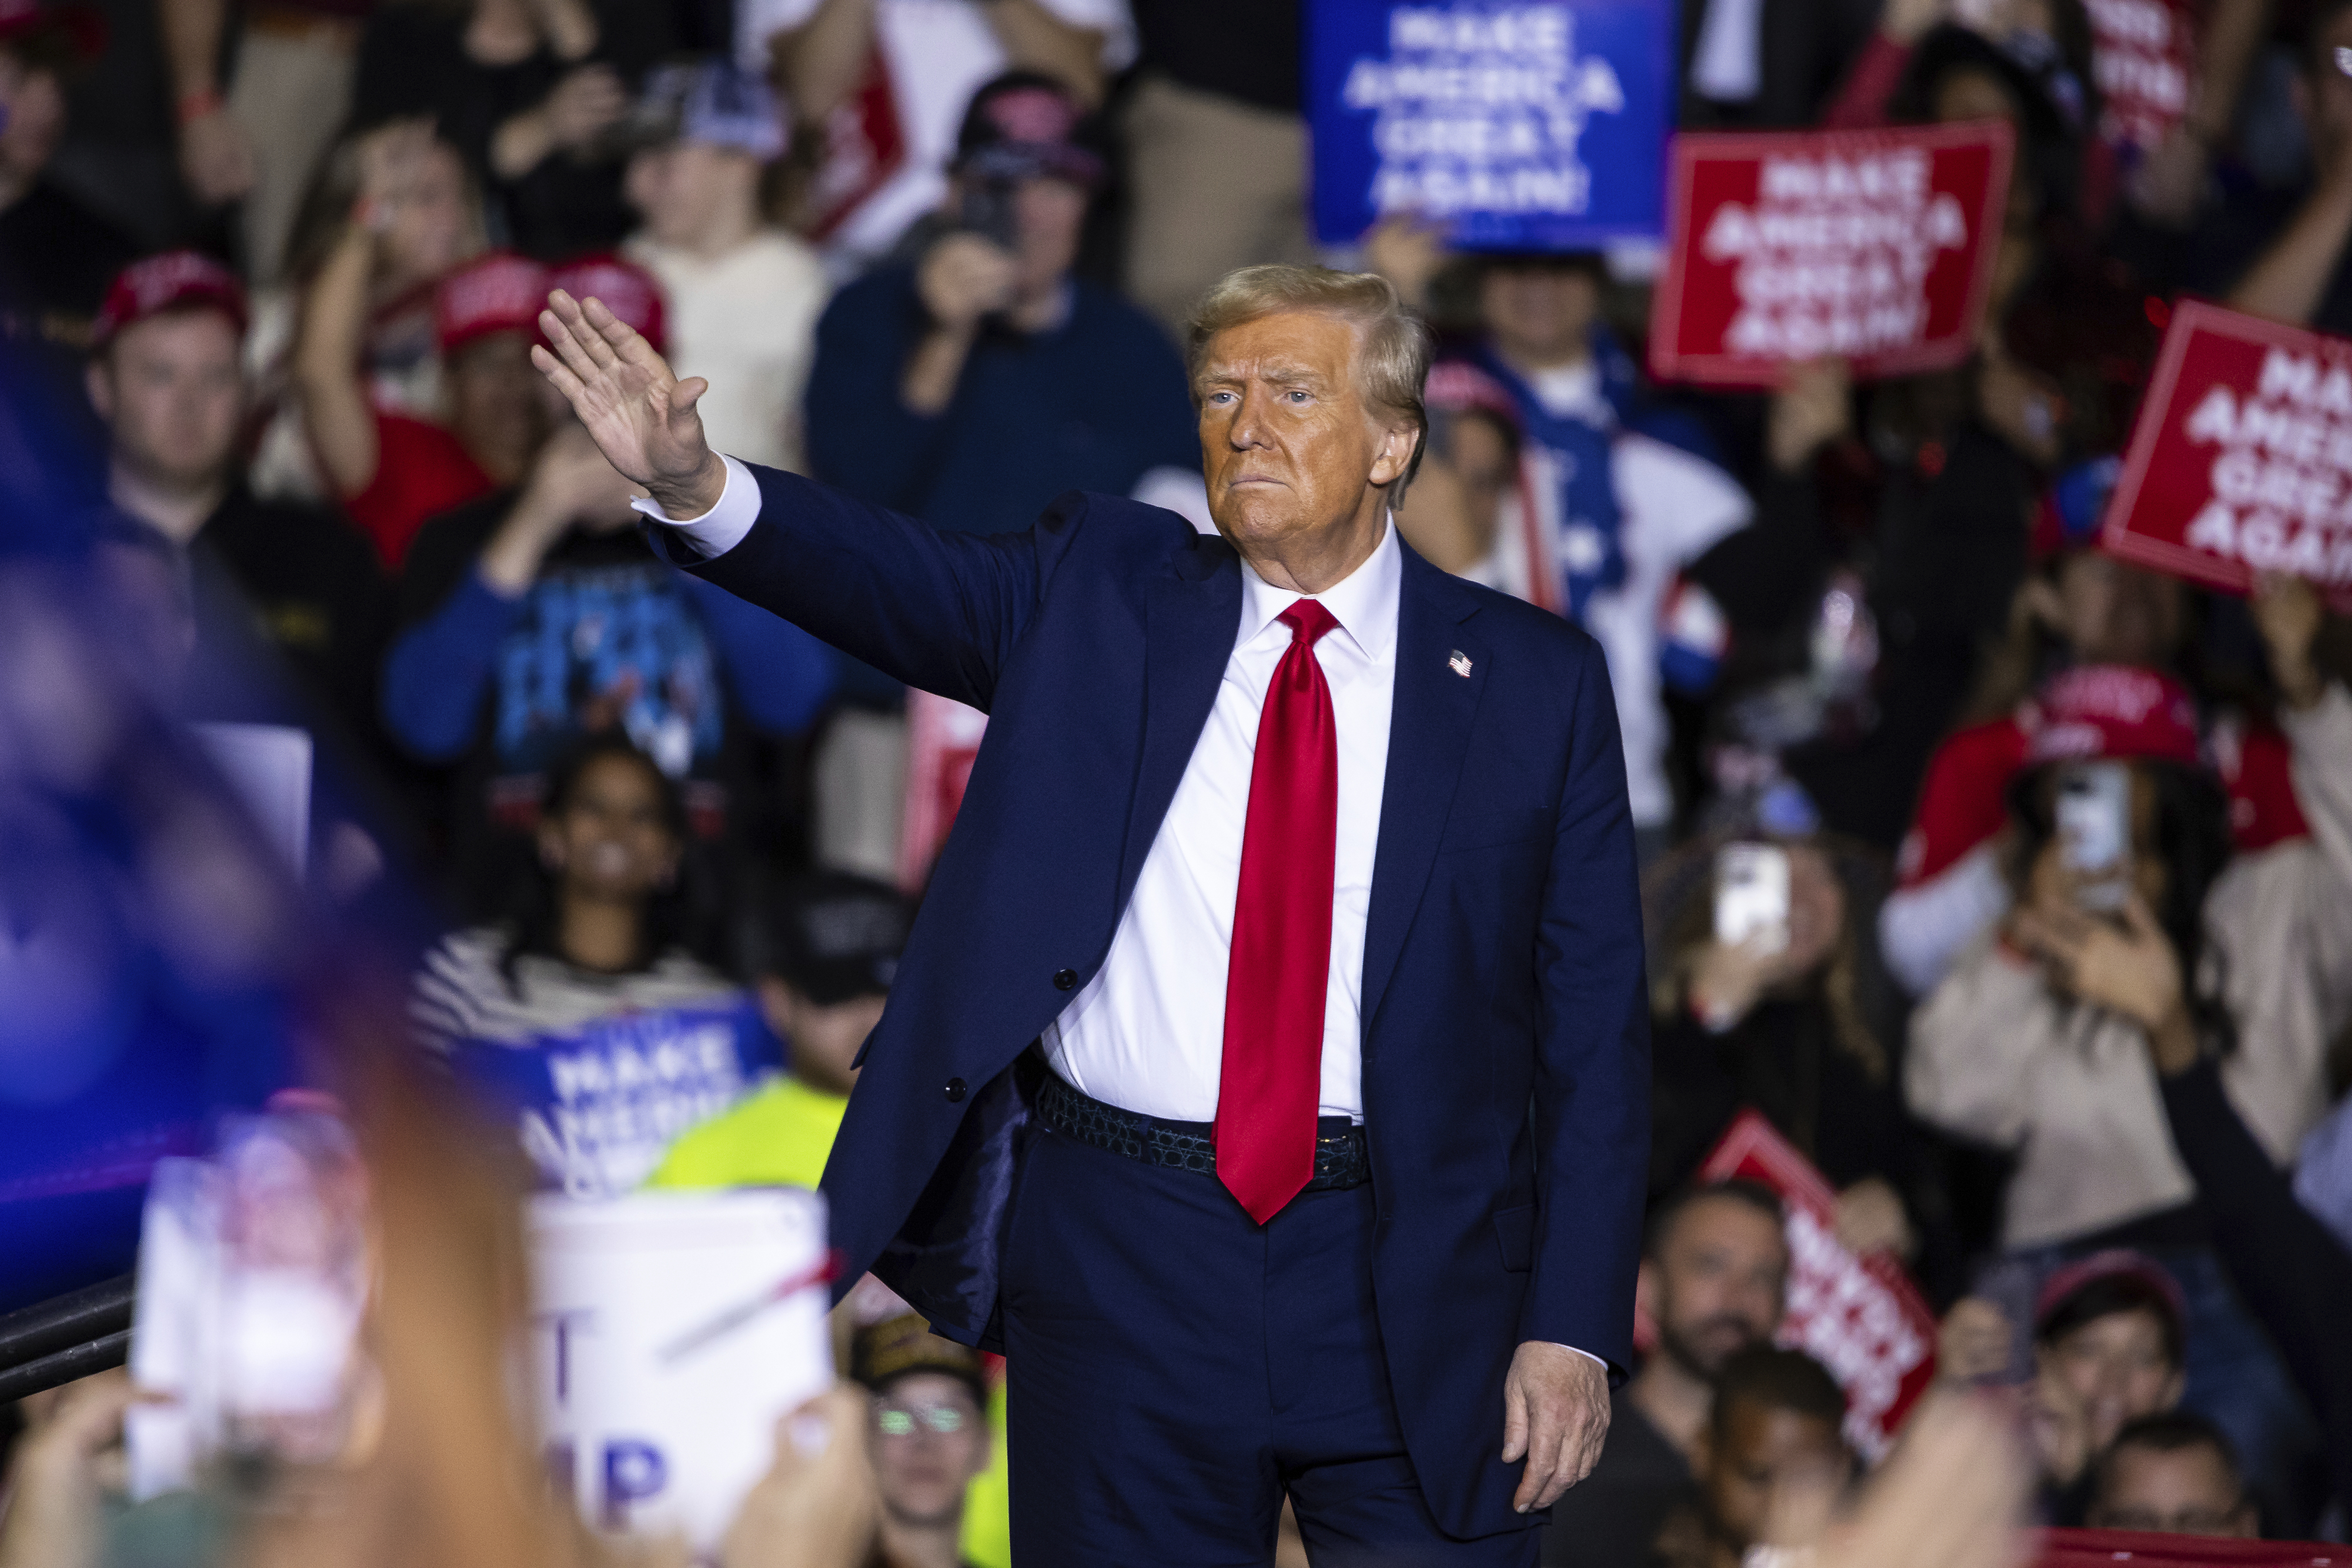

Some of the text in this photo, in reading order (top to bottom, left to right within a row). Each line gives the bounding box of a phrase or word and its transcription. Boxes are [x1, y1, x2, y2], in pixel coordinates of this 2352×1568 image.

[1389, 5, 1571, 56] MAKE
[1343, 58, 1625, 113] AMERICA
[1374, 114, 1589, 162] GREAT
[1369, 168, 1591, 216] AGAIN!
[1760, 146, 1932, 203] MAKE
[1701, 193, 1966, 263] AMERICA
[1735, 246, 1936, 306] GREAT
[547, 1024, 740, 1101] MAKE
